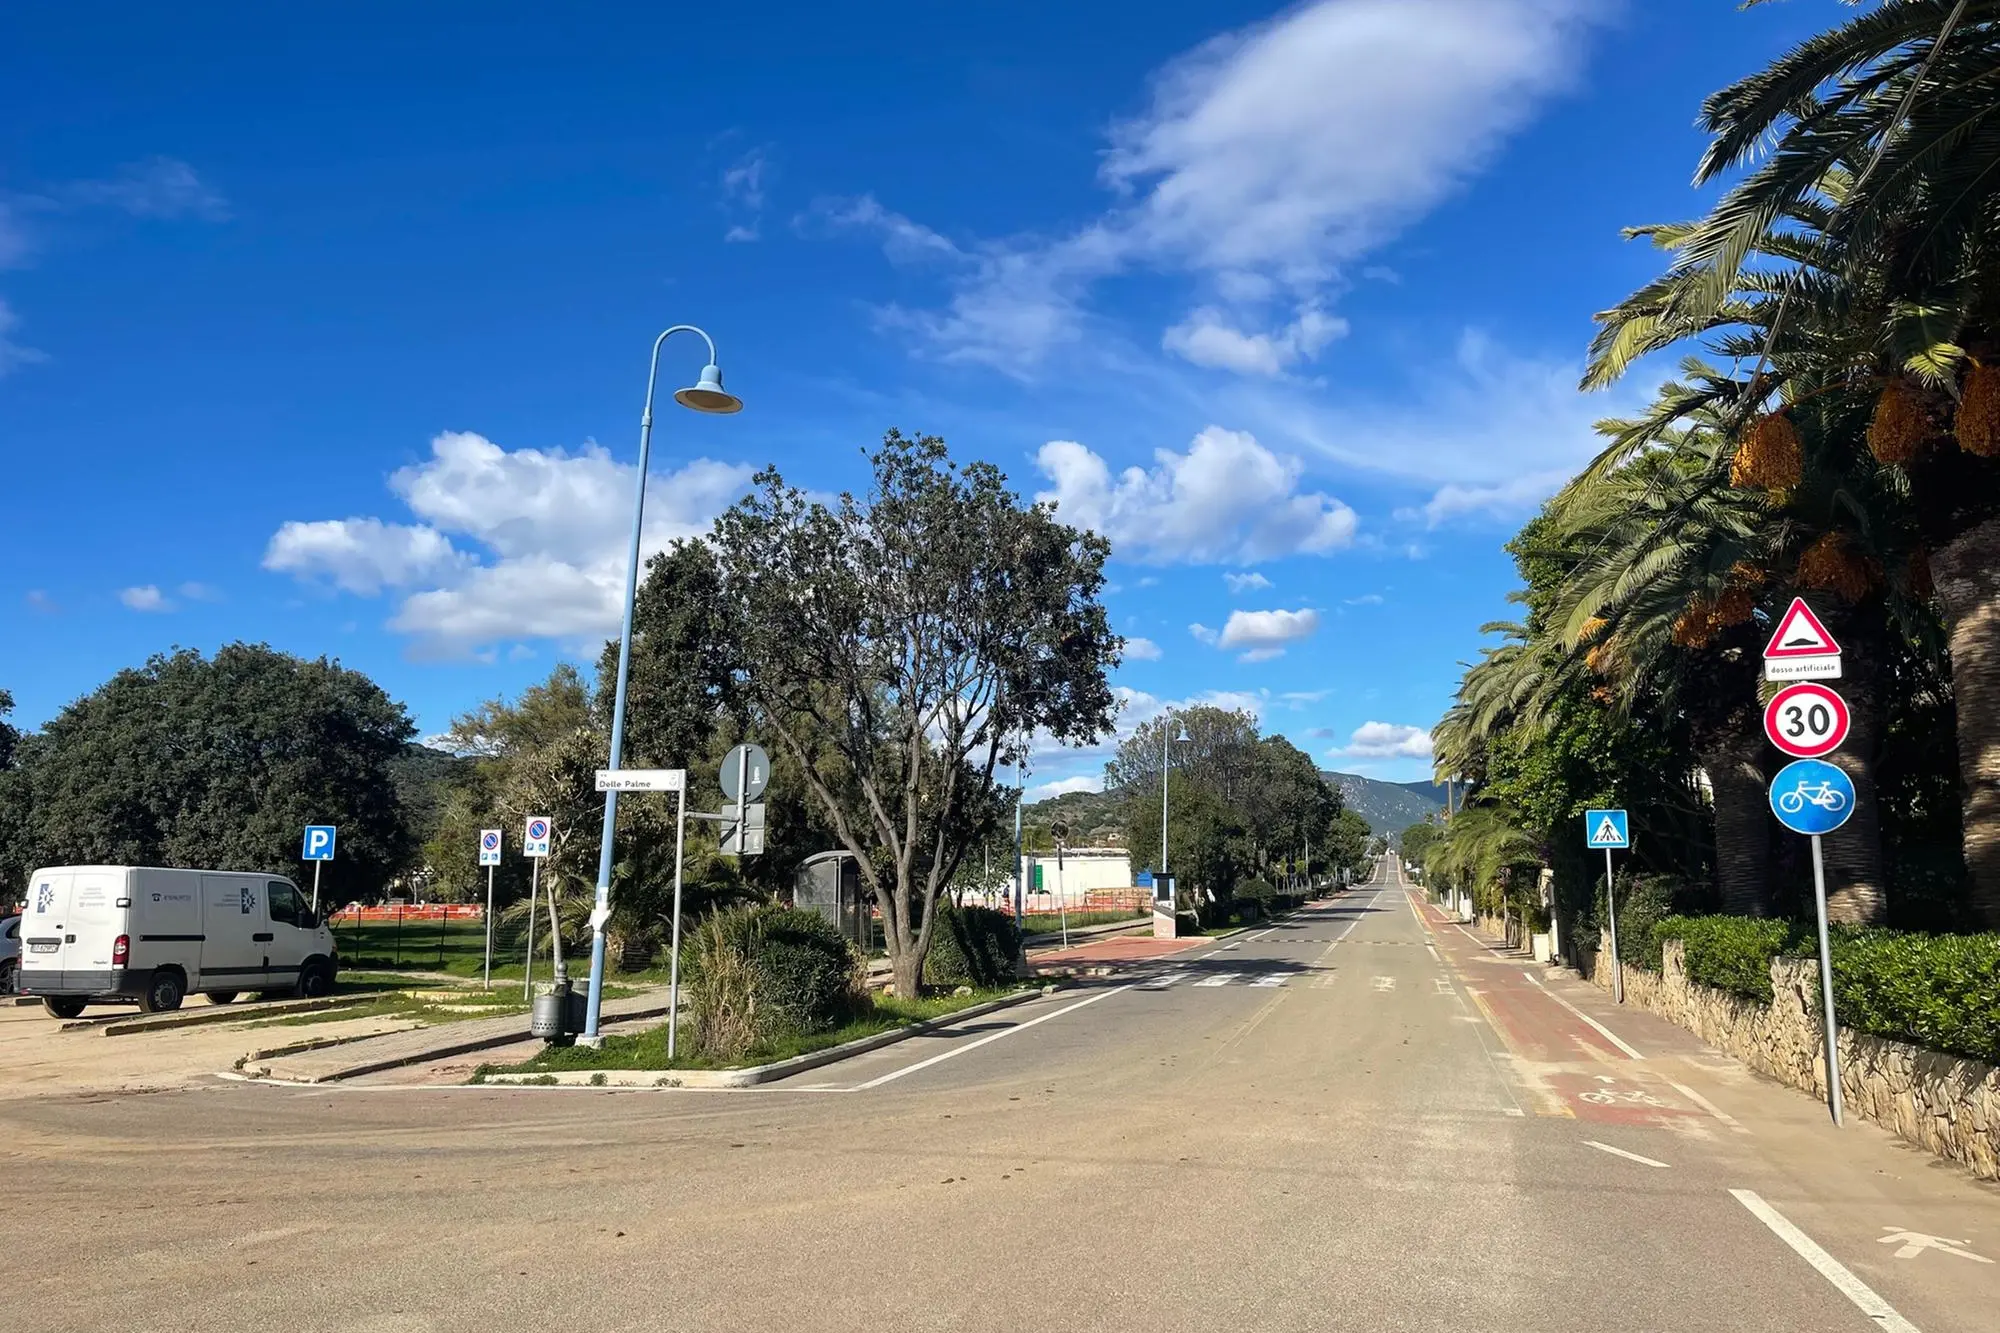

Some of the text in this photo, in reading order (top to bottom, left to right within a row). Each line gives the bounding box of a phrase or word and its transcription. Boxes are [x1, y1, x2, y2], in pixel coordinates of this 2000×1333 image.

[1771, 664, 1836, 674] dosso artificiale
[1785, 703, 1830, 737] 30
[599, 780, 651, 788] Delle Palme
[310, 830, 328, 855] P
